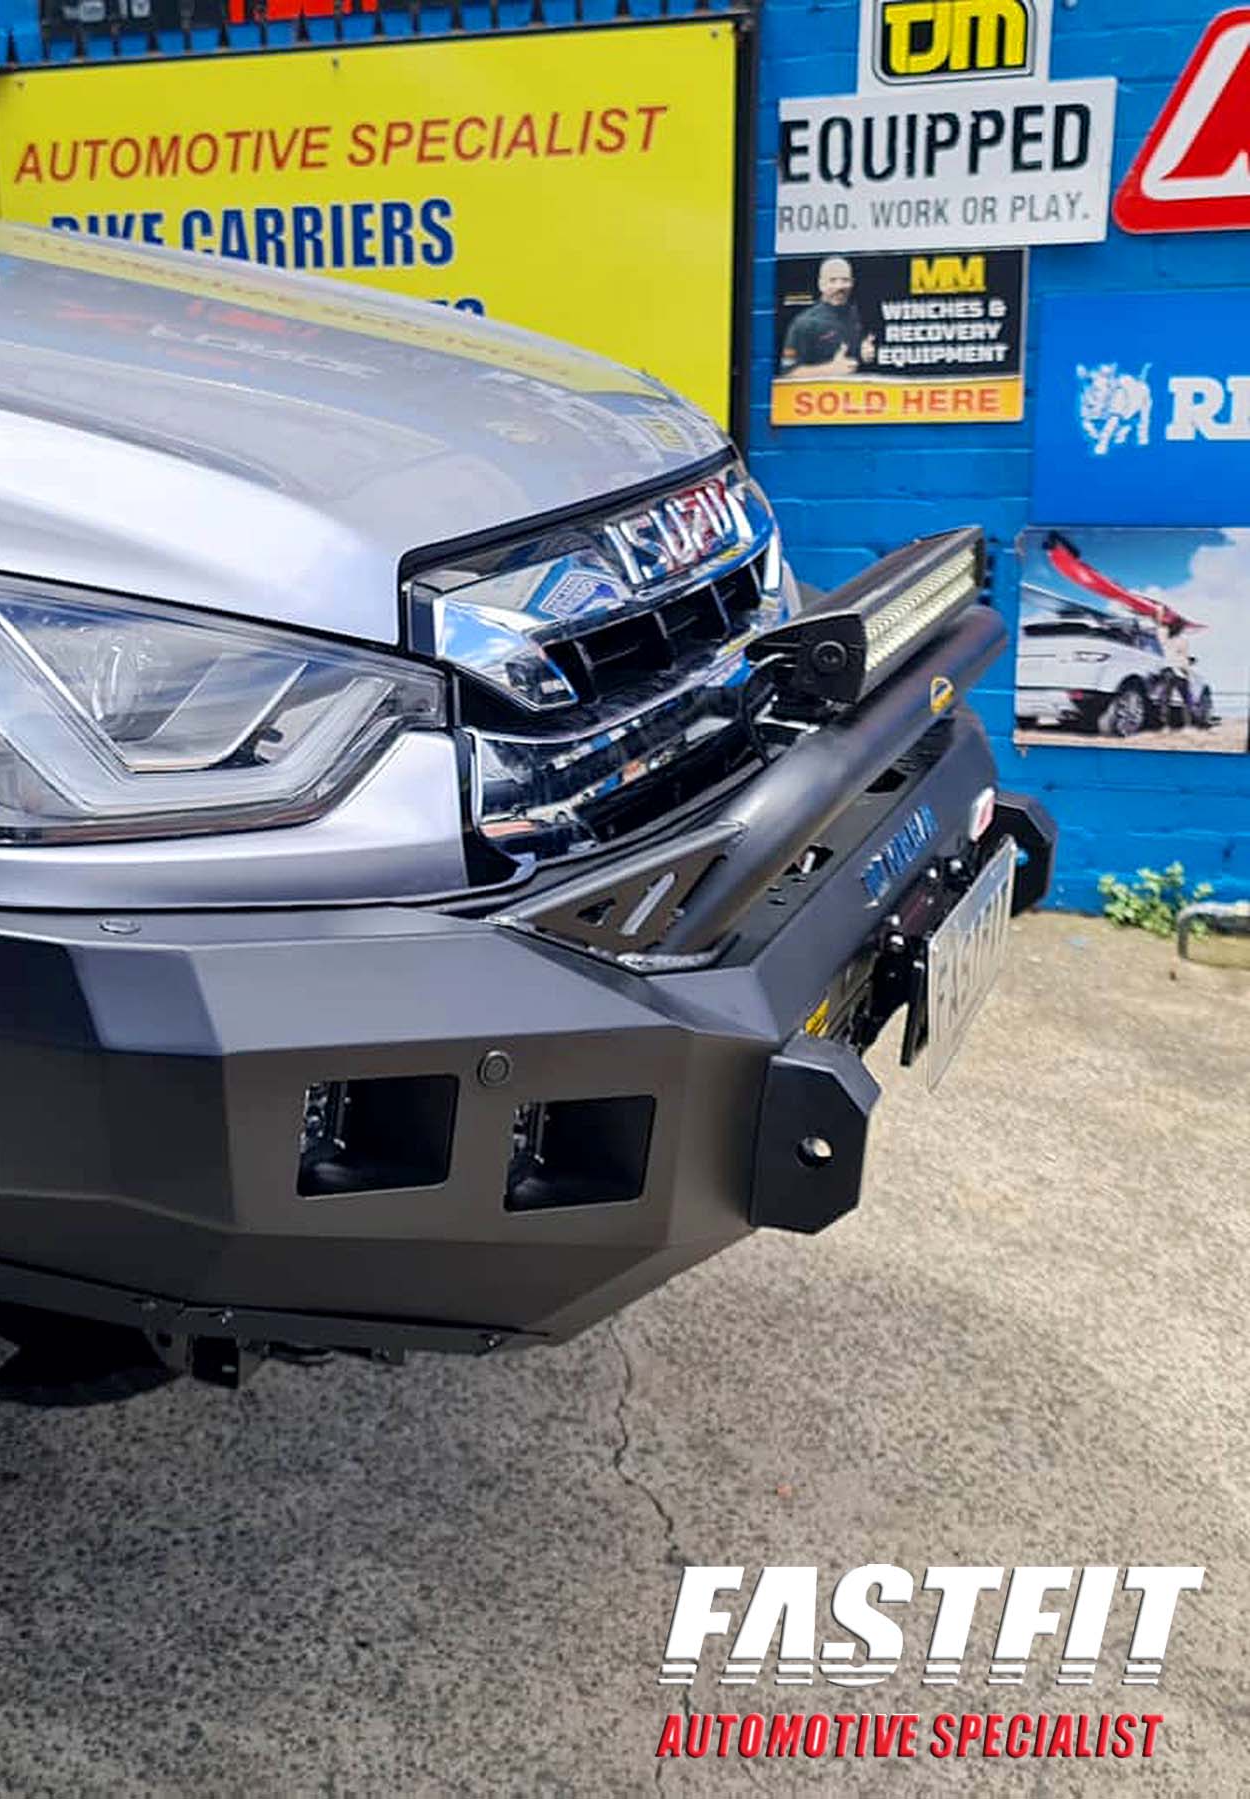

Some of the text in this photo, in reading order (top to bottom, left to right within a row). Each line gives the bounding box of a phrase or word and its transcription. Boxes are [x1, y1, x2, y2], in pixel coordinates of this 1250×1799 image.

[14, 105, 668, 184] AUTOMOTIVE SPECIALIST
[779, 103, 1091, 189] EQUIPPED
[777, 192, 1090, 234] ROAD. WORK OR PLAY.
[181, 198, 454, 269] CARRIERS
[910, 255, 987, 294] MM
[881, 301, 985, 321] WINCHES
[885, 322, 1003, 344] RECOVERY
[876, 344, 1009, 368] EQUIPMENT
[794, 387, 1000, 416] SOLD HERE
[603, 482, 753, 585] ISUZU
